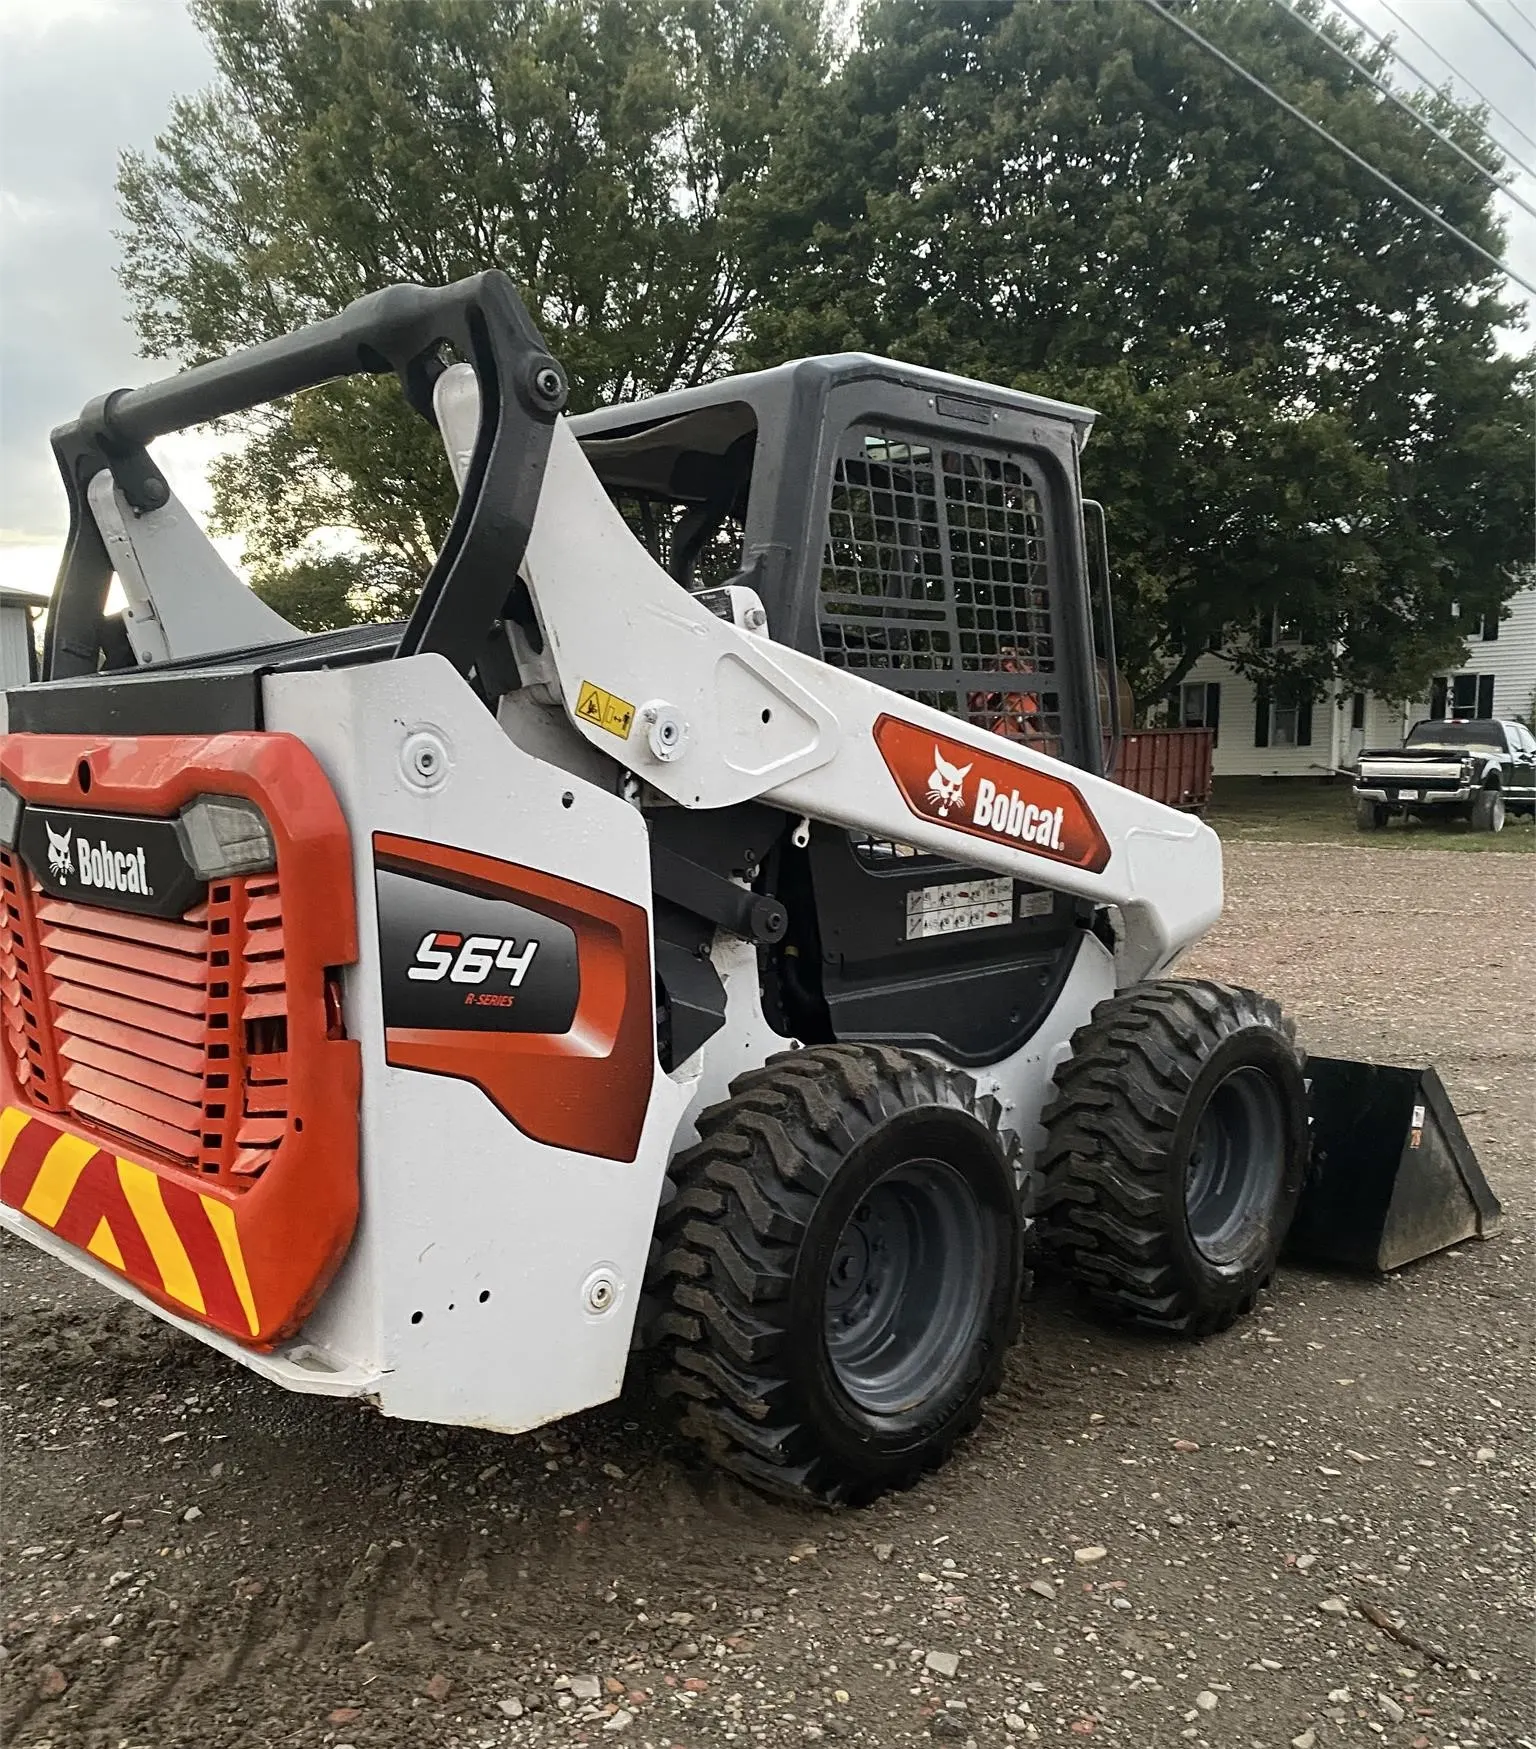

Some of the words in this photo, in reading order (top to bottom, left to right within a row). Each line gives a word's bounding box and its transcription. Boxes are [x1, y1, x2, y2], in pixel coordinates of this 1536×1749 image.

[973, 778, 1063, 850] Bobcat
[77, 838, 149, 896] Bobcat
[407, 932, 538, 987] S64
[464, 993, 515, 1007] R-SERIES
